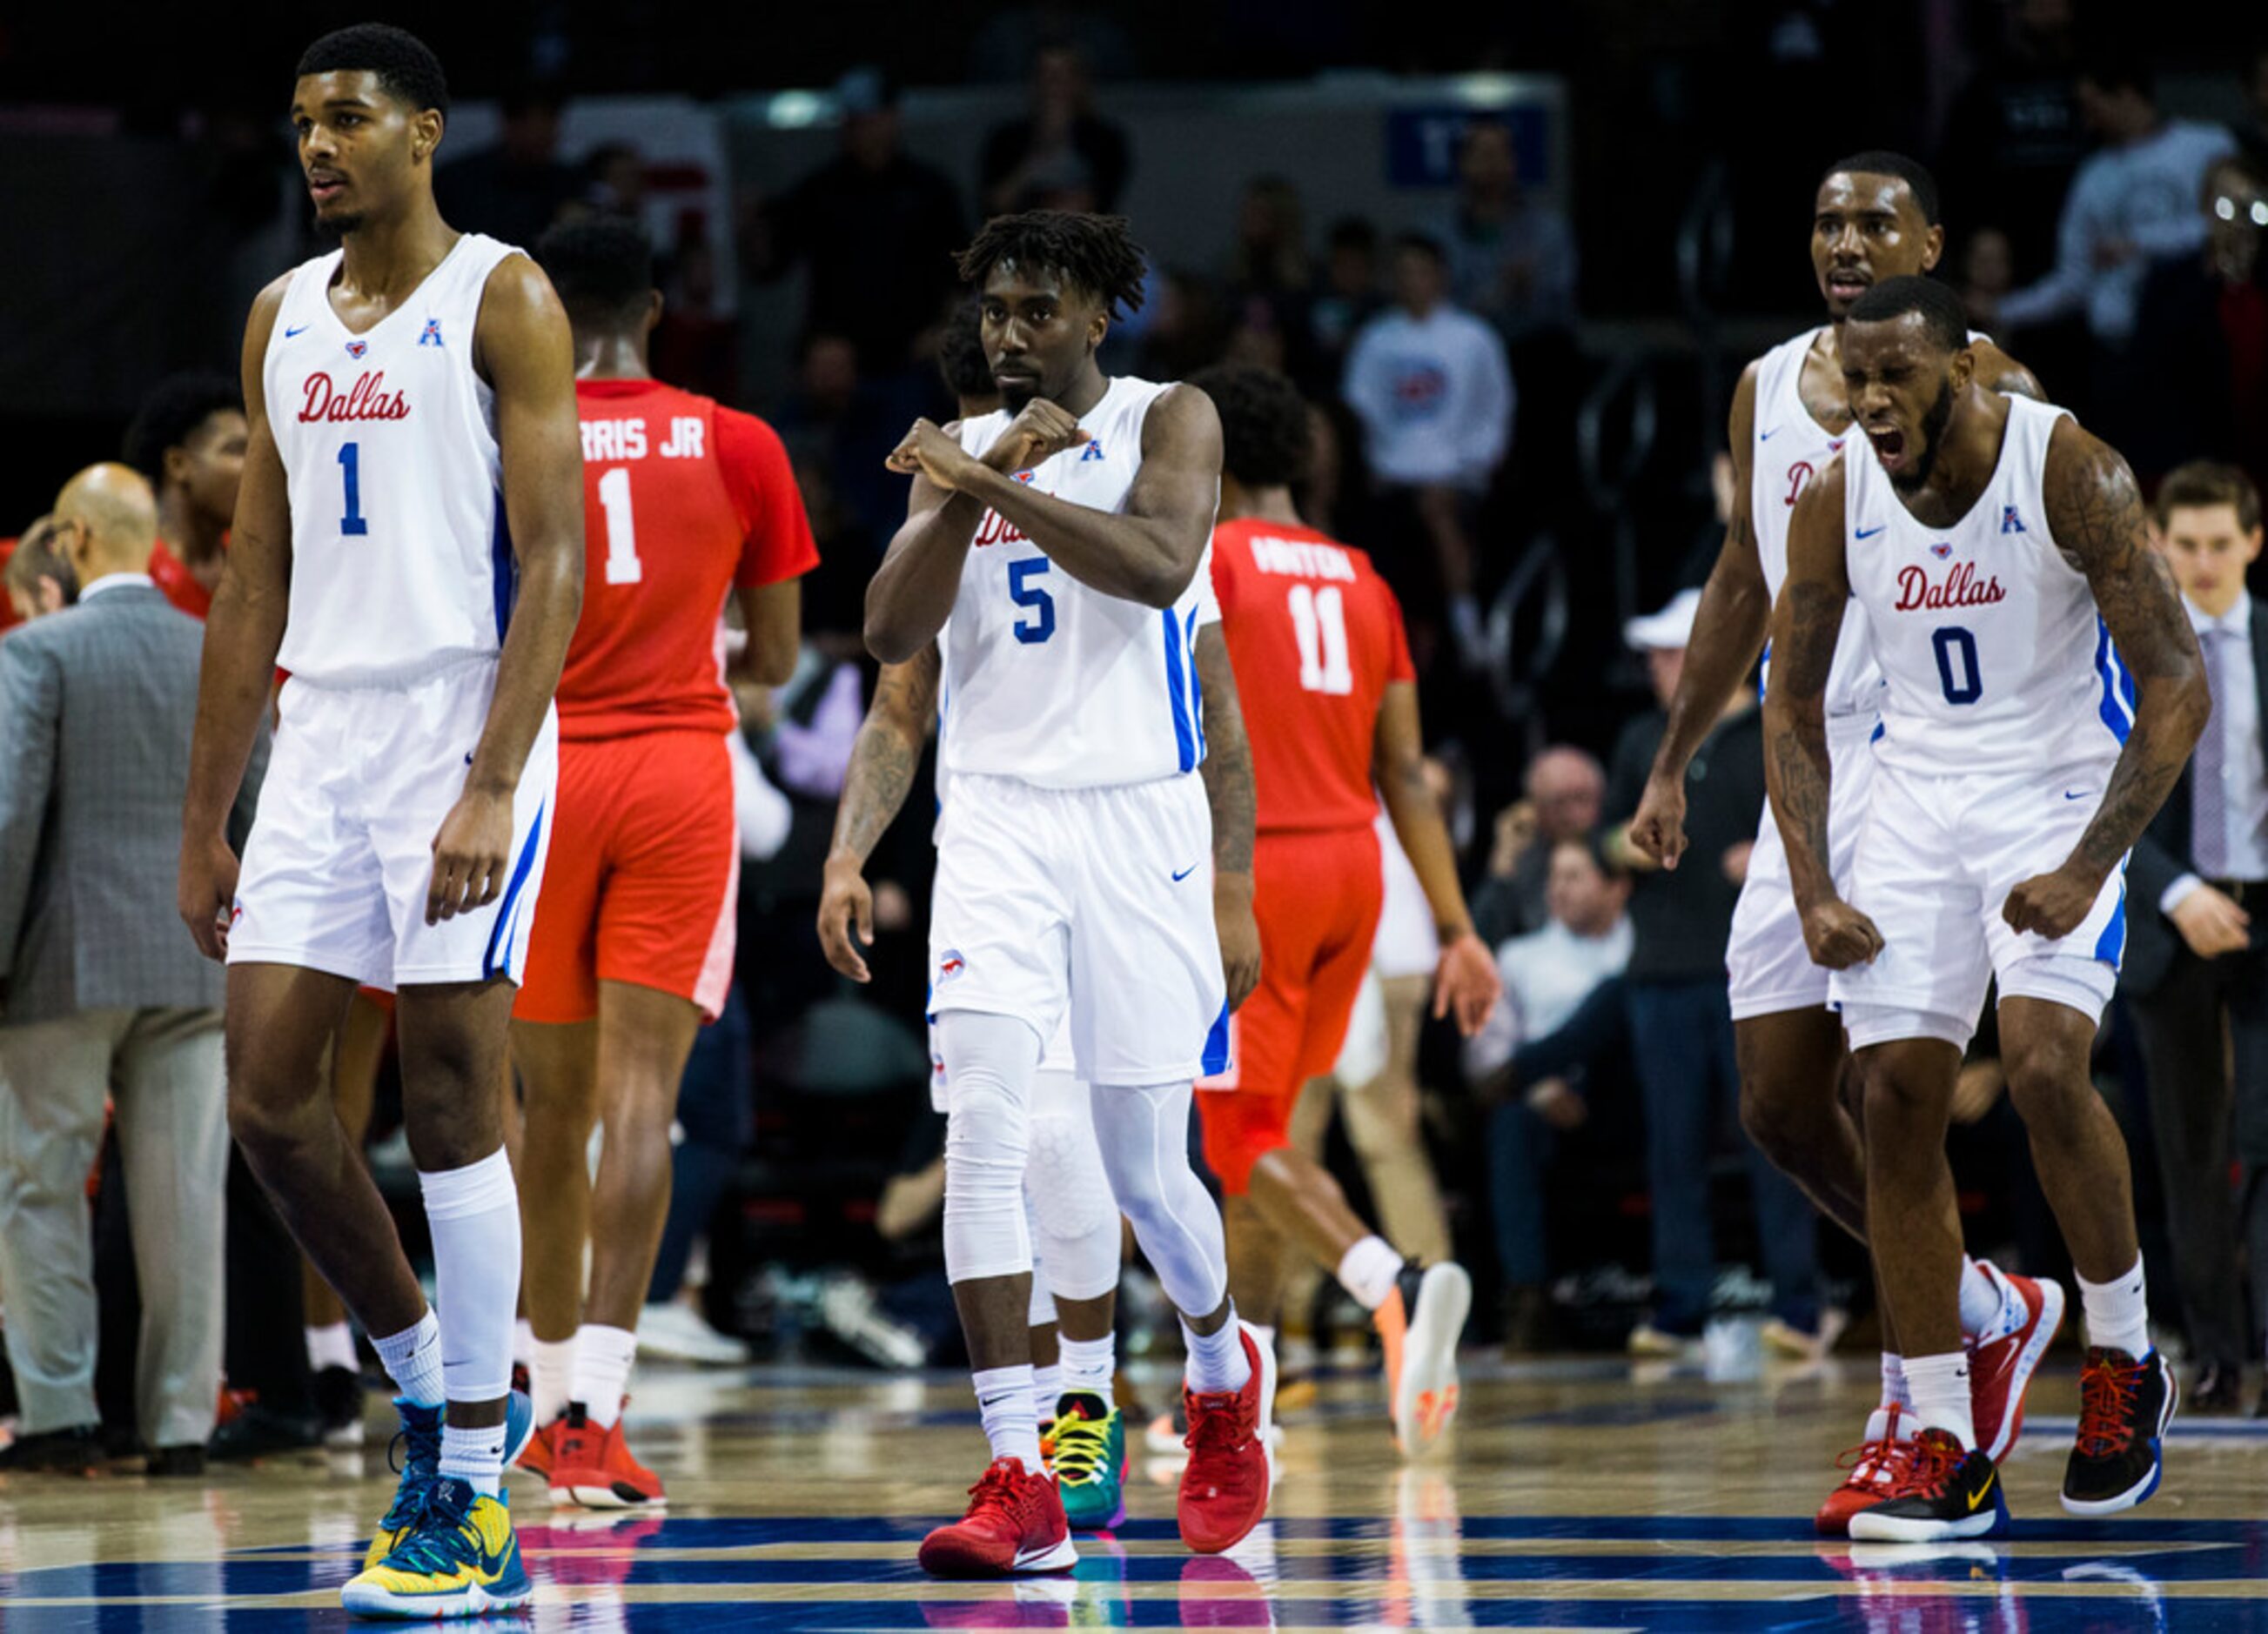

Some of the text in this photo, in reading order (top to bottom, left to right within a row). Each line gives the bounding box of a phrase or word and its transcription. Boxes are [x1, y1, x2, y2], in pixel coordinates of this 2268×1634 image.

[299, 371, 411, 423] Dallas
[659, 416, 704, 459] JR
[338, 442, 367, 536] 1
[598, 467, 642, 585] 1
[1008, 556, 1056, 644] 5
[1895, 561, 2006, 611] Dallas
[1287, 584, 1352, 694] 11
[1932, 626, 1983, 705] 0
